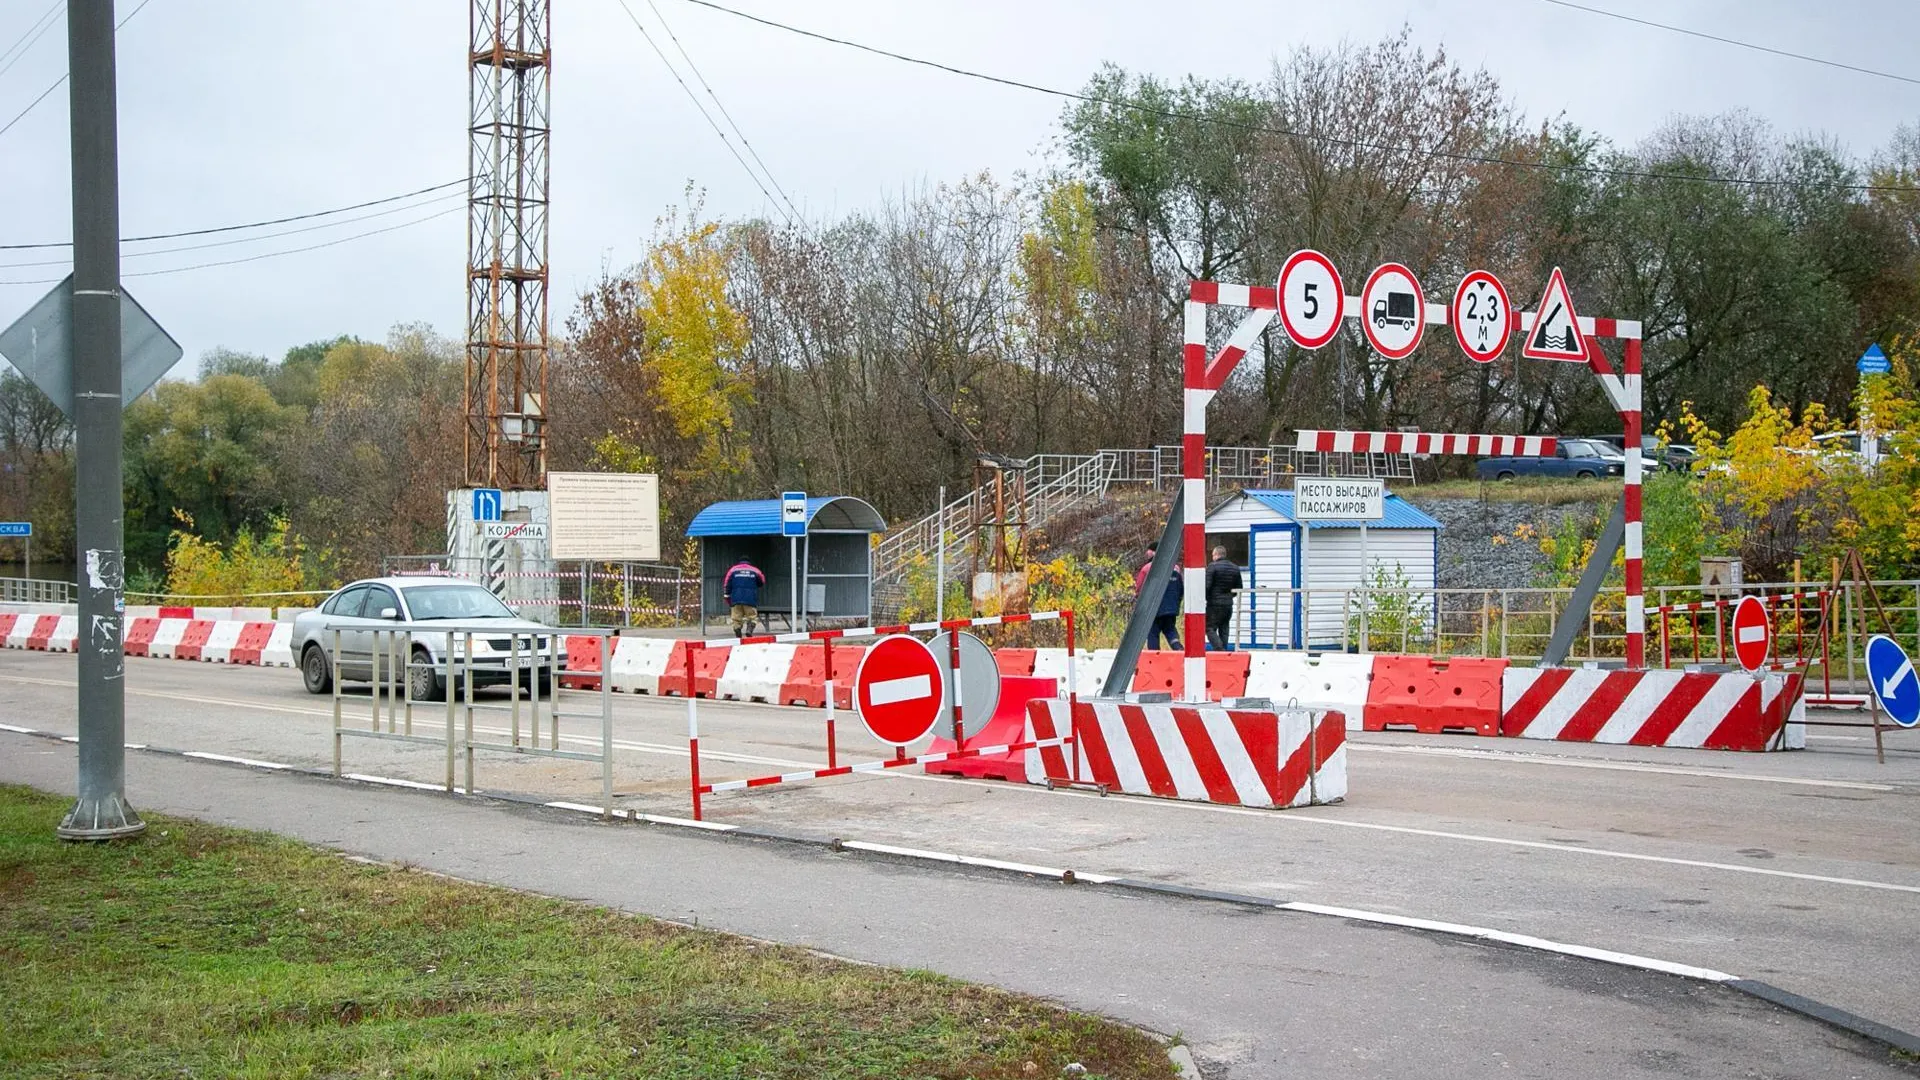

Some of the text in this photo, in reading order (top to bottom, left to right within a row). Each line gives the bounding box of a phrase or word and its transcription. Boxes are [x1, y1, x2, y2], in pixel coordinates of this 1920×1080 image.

[1303, 283, 1319, 320] 5
[1466, 292, 1498, 324] 2,3
[1477, 325, 1488, 340] М
[1301, 485, 1379, 498] МЕСТО ВЫСАДКИ
[1300, 501, 1366, 513] ПАССАЖИРОВ
[488, 525, 543, 536] КОЛОМНА
